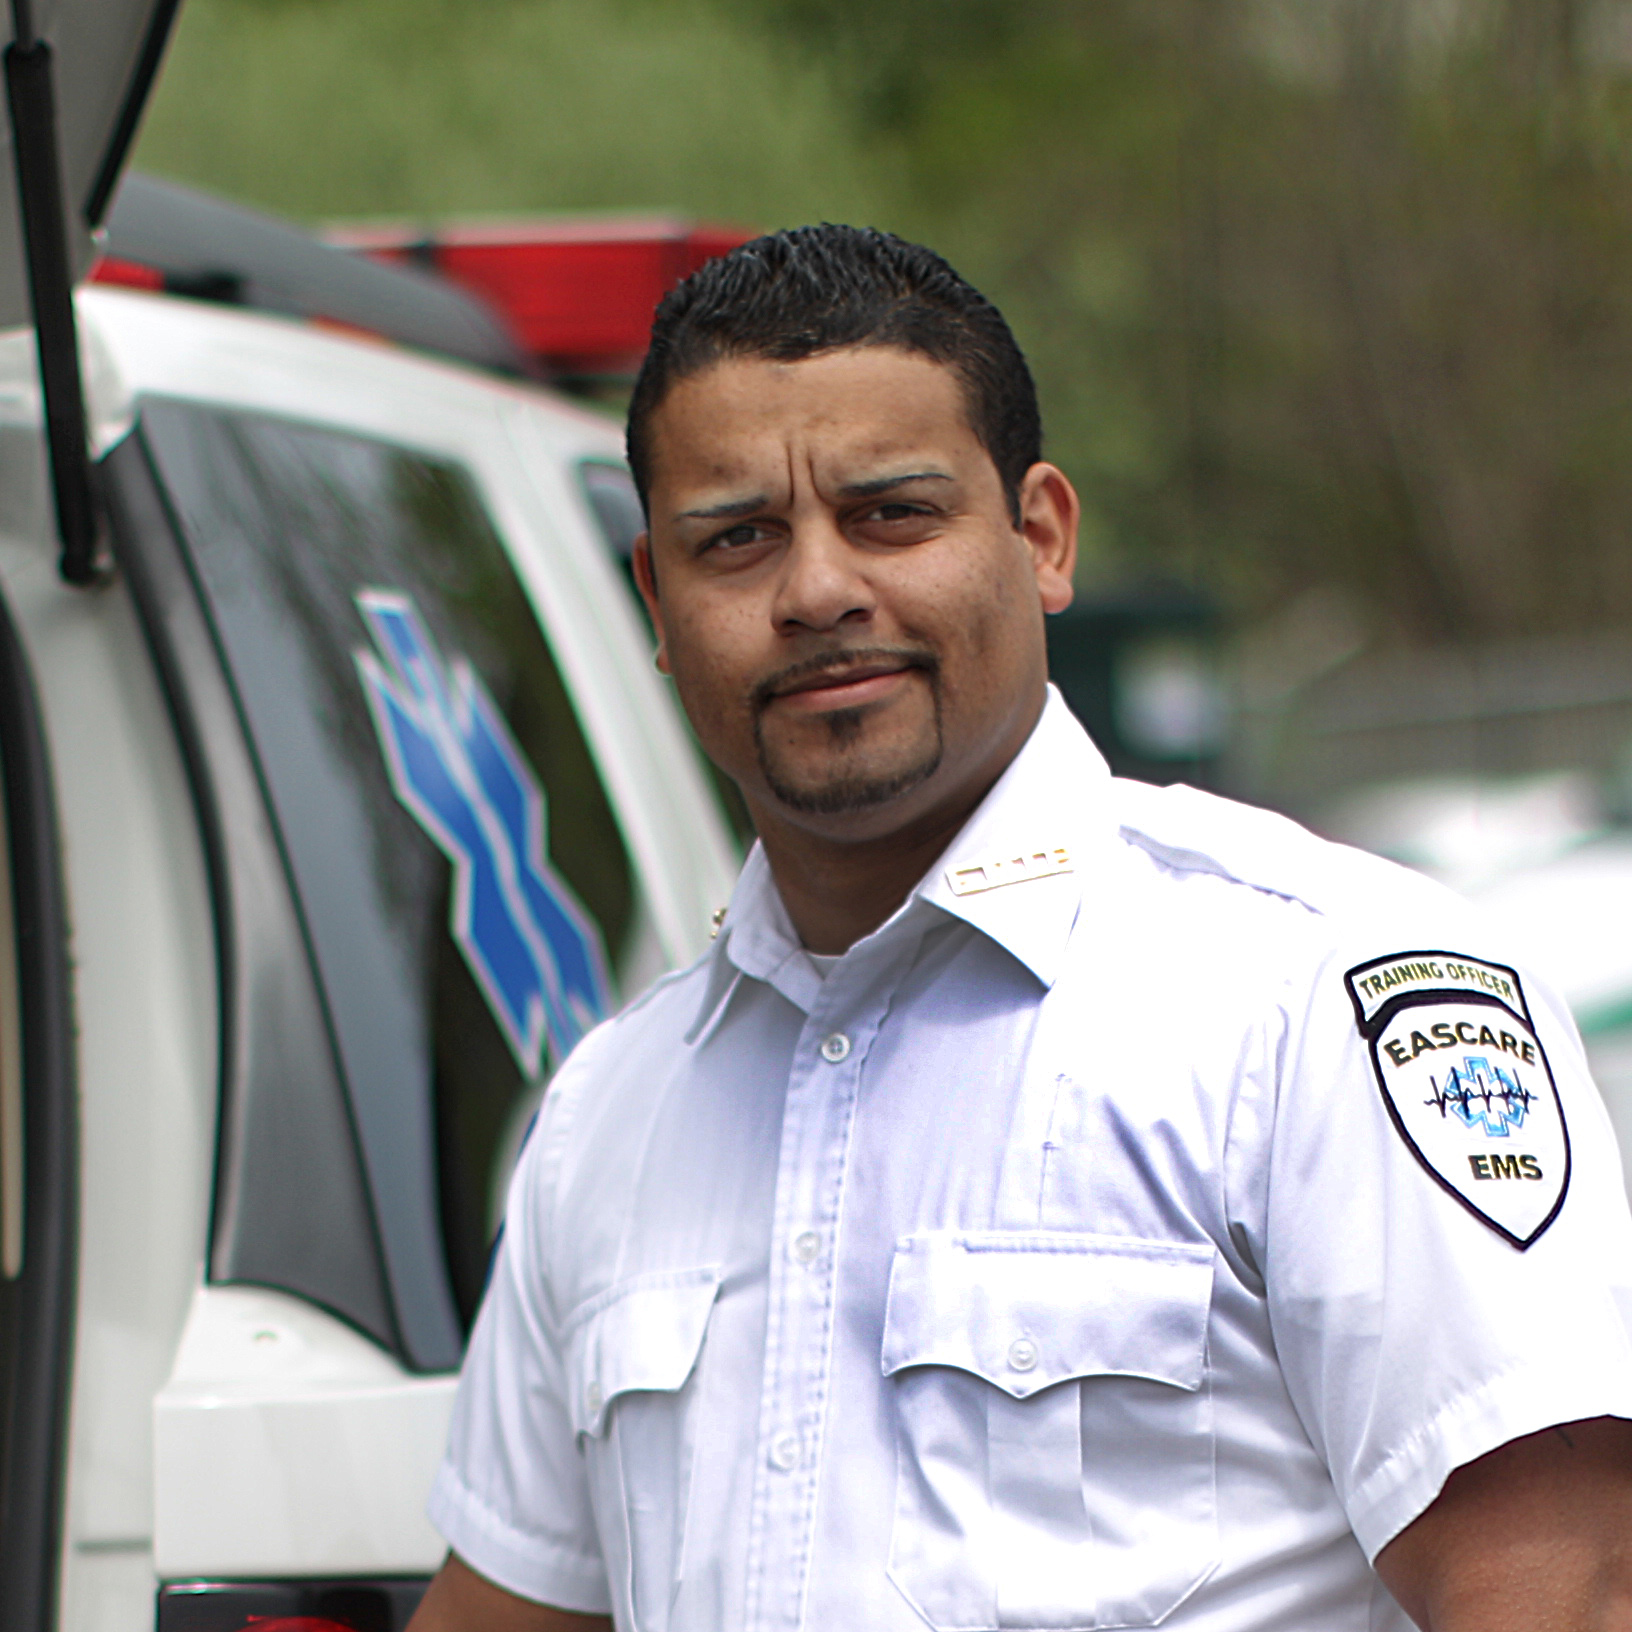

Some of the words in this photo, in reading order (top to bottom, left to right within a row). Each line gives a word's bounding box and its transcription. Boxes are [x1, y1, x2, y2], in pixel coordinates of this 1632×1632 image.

[1358, 961, 1443, 999] TRAINING
[1446, 963, 1515, 1002] OFFICER
[1383, 1021, 1536, 1067] EASCARE
[1467, 1154, 1543, 1180] EMS
